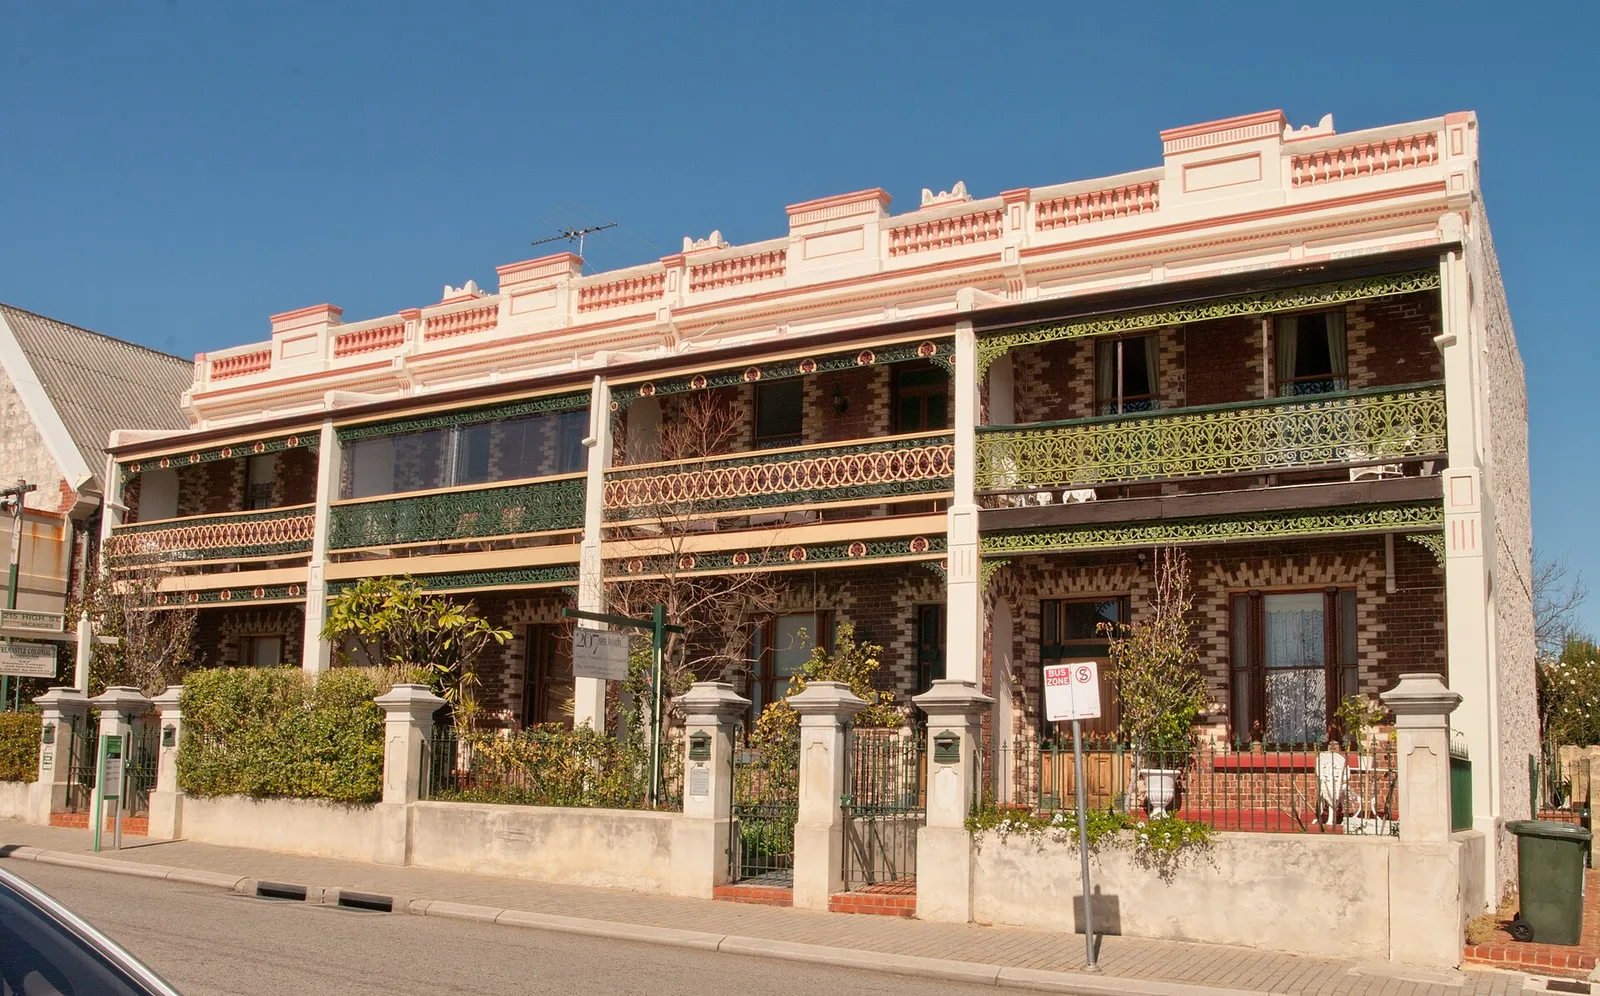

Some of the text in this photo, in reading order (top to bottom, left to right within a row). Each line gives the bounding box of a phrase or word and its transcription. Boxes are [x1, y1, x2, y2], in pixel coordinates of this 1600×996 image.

[3, 612, 18, 620] 215
[22, 613, 45, 621] HIGH
[21, 621, 54, 629] VACANCIES
[576, 632, 600, 655] 207
[0, 646, 26, 655] REMANTLE
[1048, 668, 1067, 678] BUS
[1047, 676, 1070, 686] ZONE
